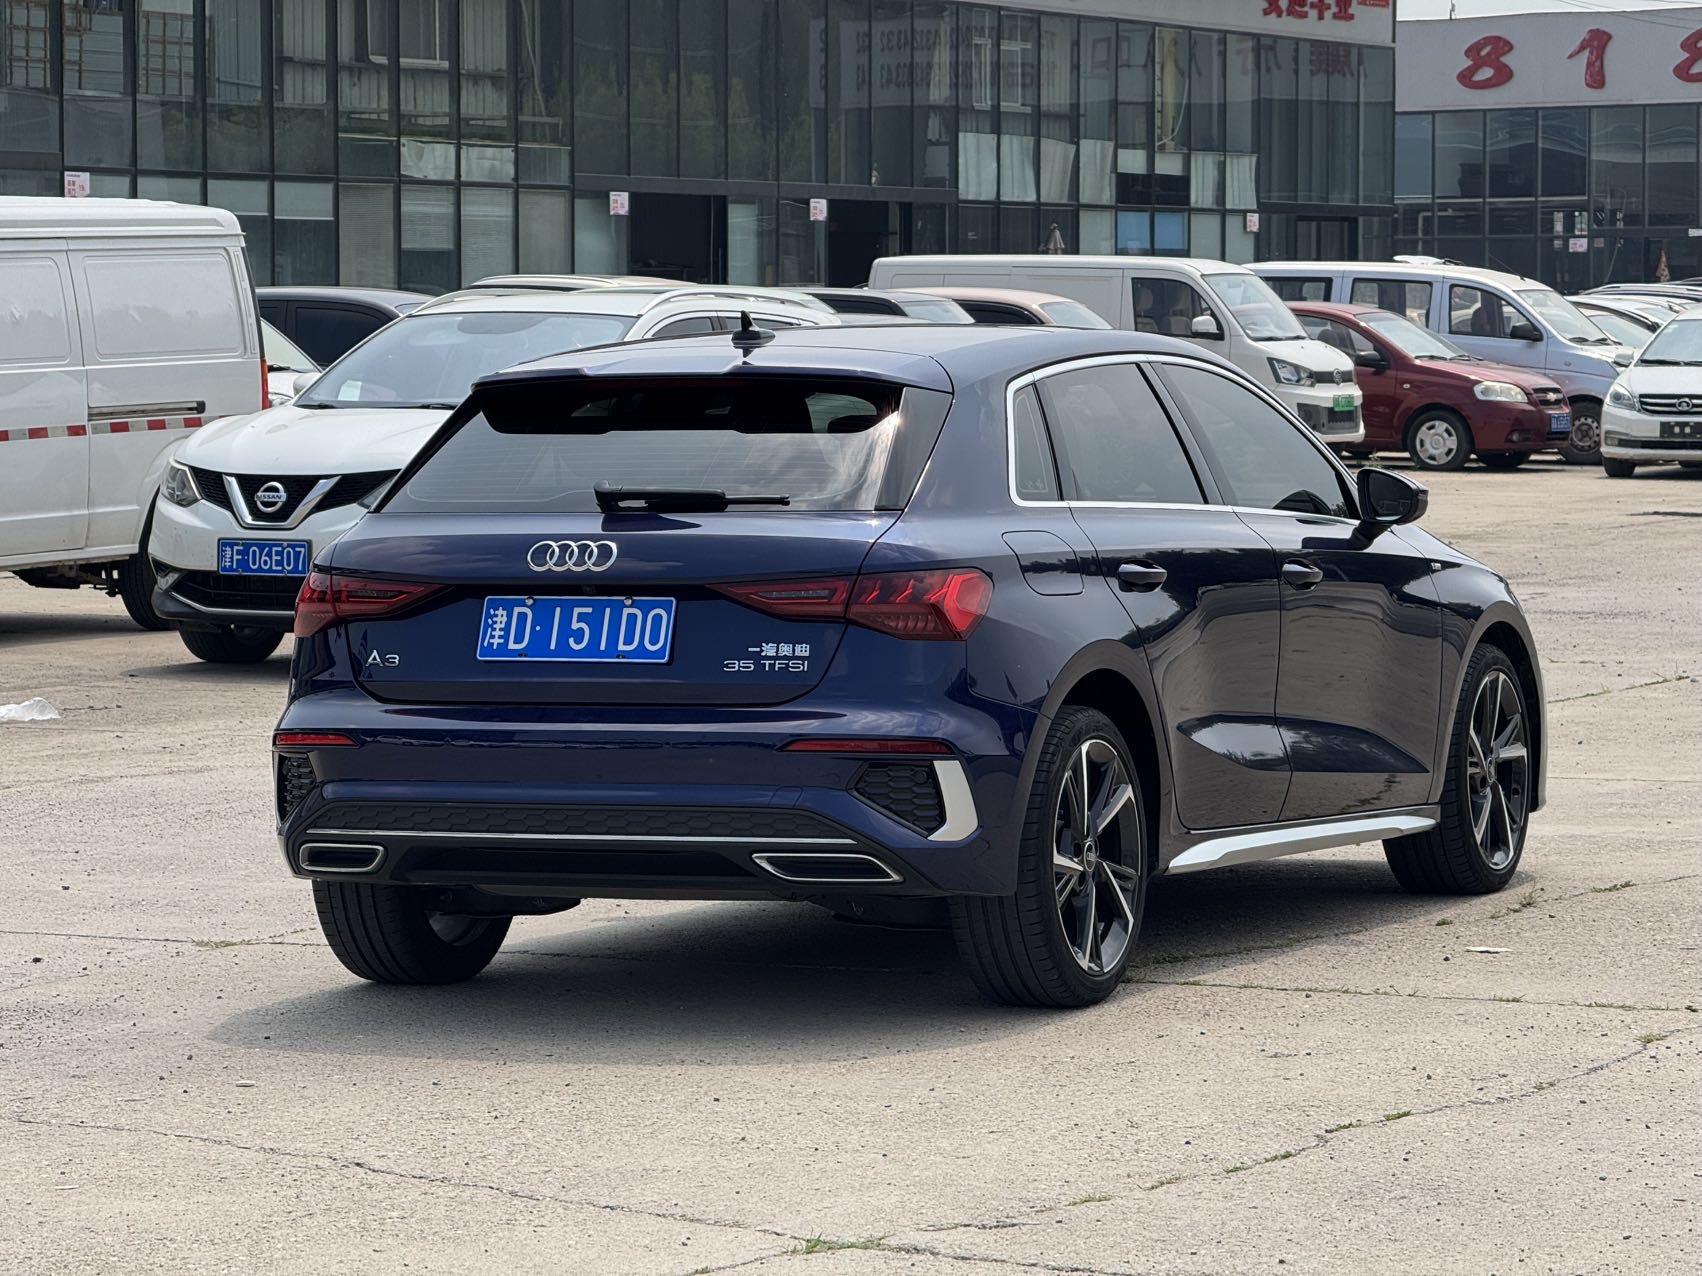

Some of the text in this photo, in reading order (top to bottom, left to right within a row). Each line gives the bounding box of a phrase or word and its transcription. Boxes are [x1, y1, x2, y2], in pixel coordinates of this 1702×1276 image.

[748, 643, 810, 656] 一汽奥迪
[365, 649, 400, 666] A3
[723, 660, 808, 671] 35 TFSI
